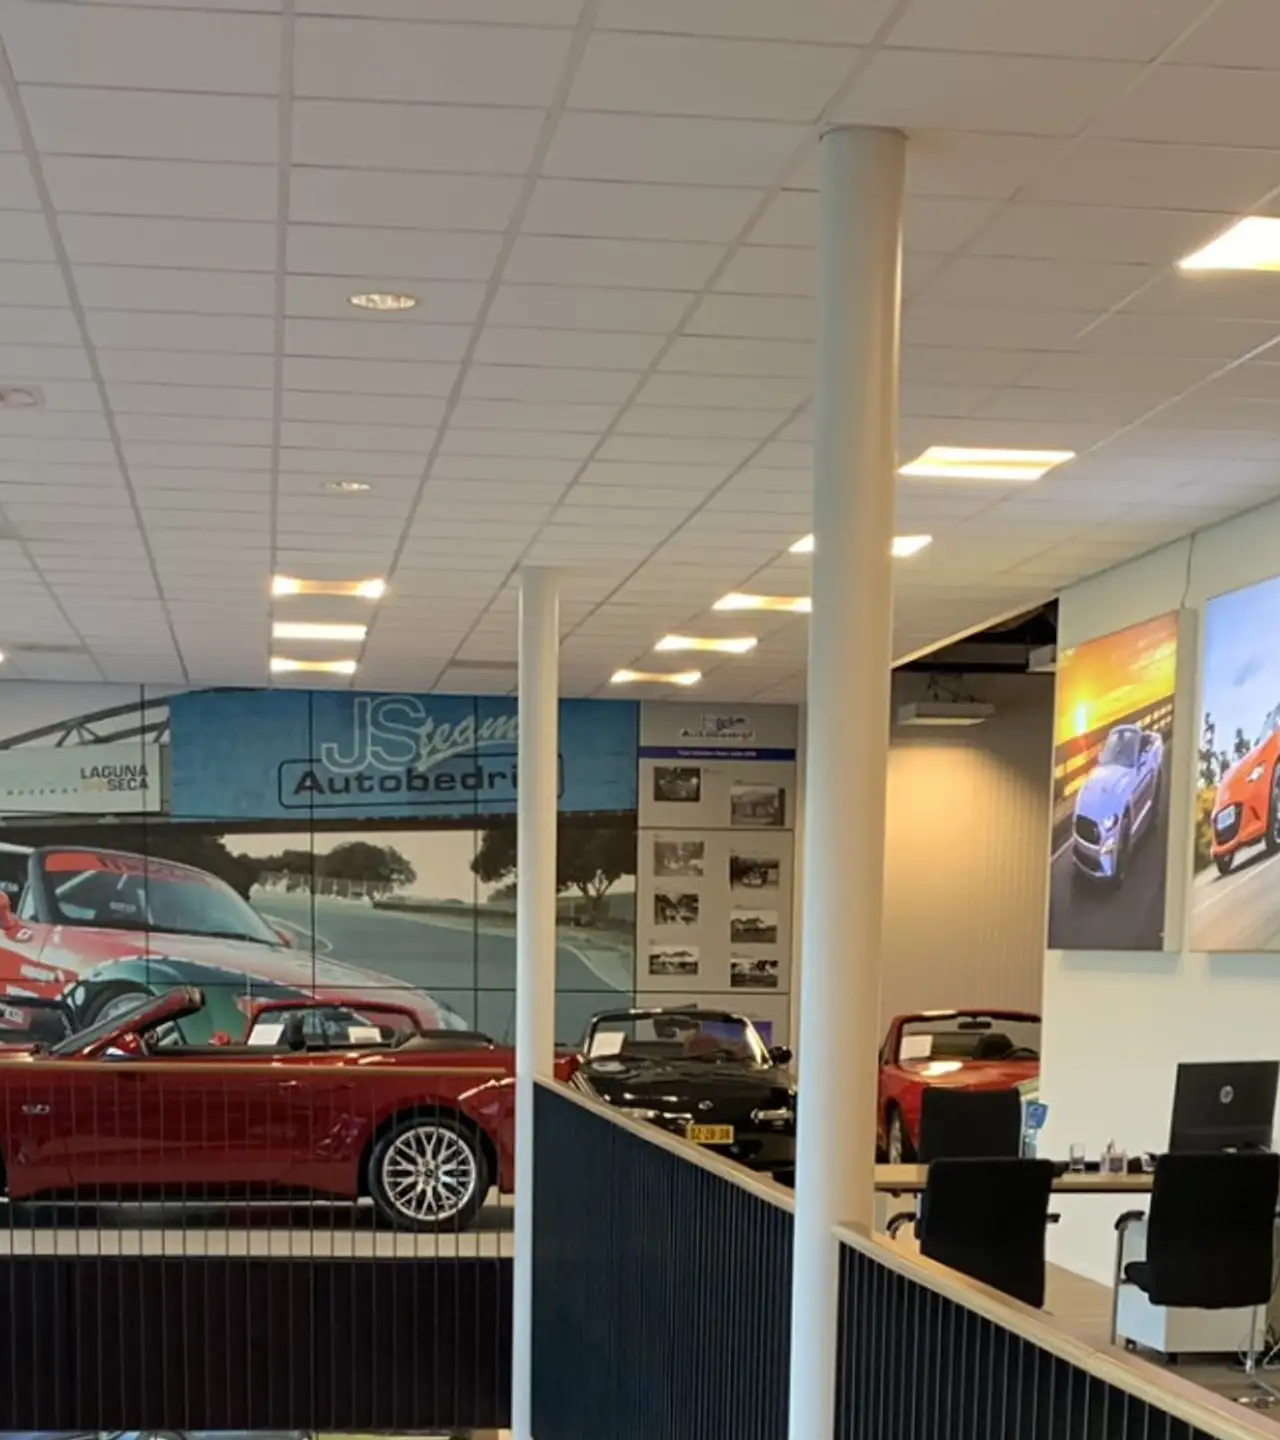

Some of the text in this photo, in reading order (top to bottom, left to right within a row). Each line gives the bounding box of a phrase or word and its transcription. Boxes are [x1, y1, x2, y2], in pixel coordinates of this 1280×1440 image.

[79, 764, 149, 778] LAGUNA
[106, 777, 150, 792] SECA
[293, 765, 519, 796] Autobedri
